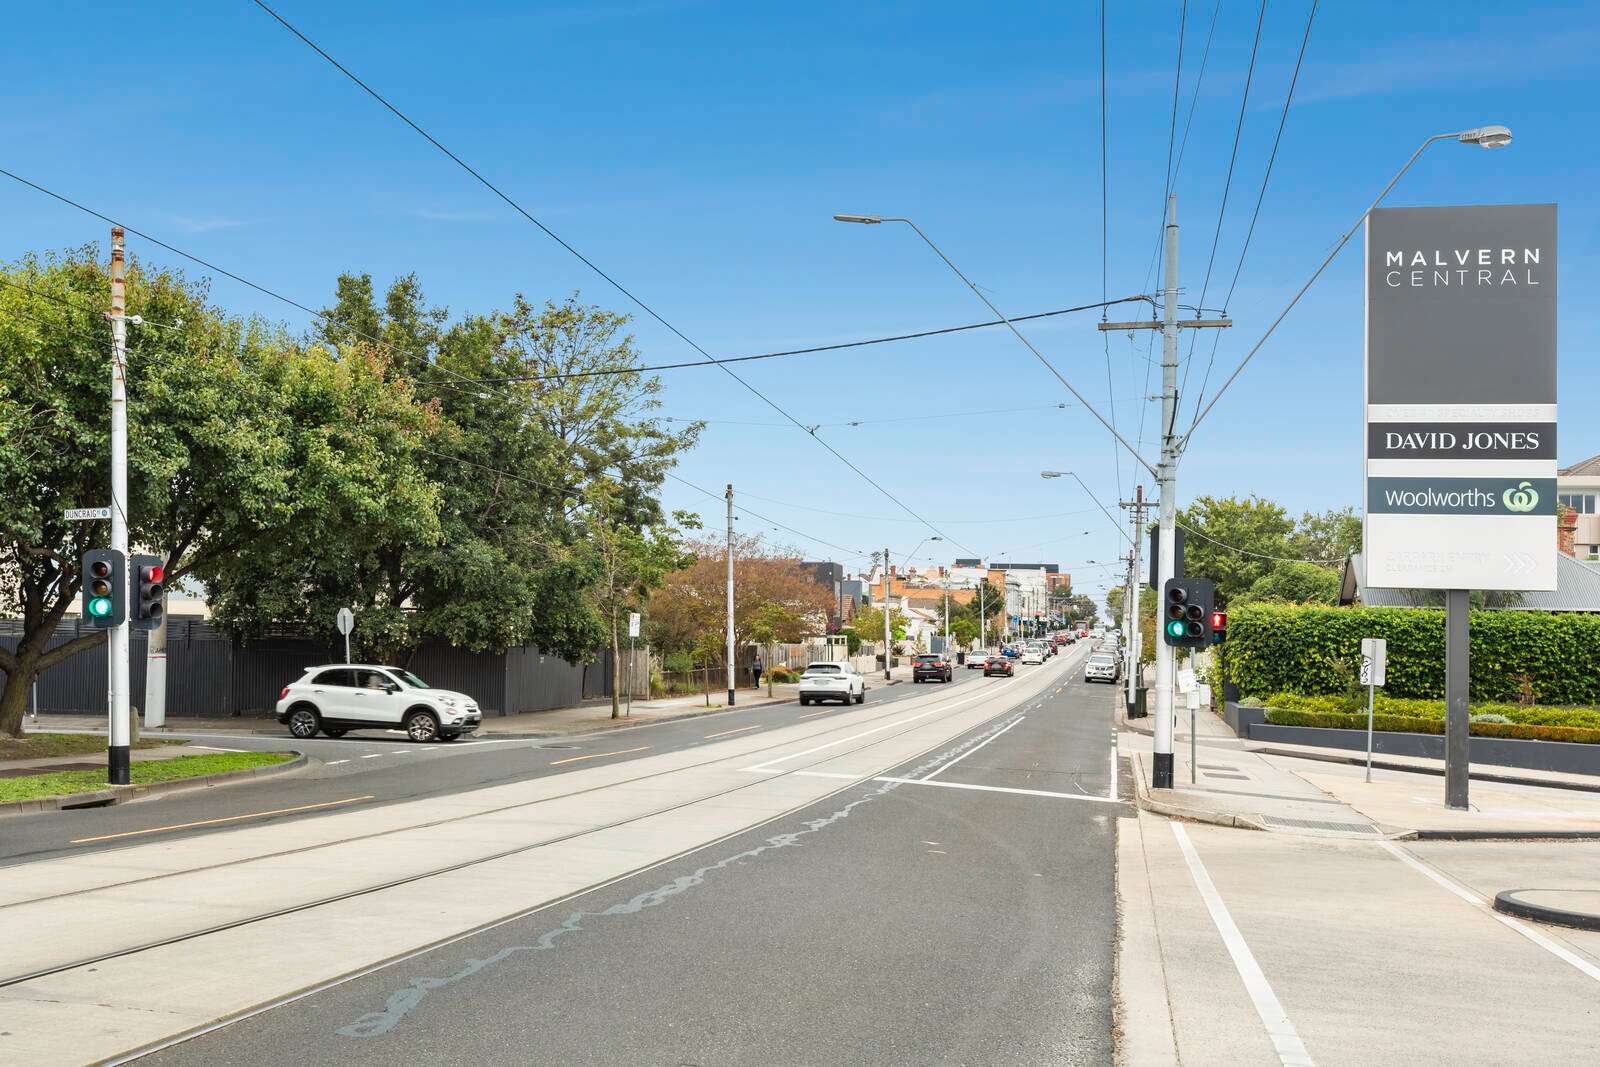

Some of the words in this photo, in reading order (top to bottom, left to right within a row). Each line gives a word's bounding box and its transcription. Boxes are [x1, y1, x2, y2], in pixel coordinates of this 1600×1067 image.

[1386, 248, 1540, 267] MALVERN
[1386, 268, 1540, 287] CENTRAL
[1385, 432, 1456, 450] DAVID
[1462, 432, 1539, 450] JONES
[1385, 487, 1496, 507] Woolworths
[65, 509, 97, 519] DUNCRAIG
